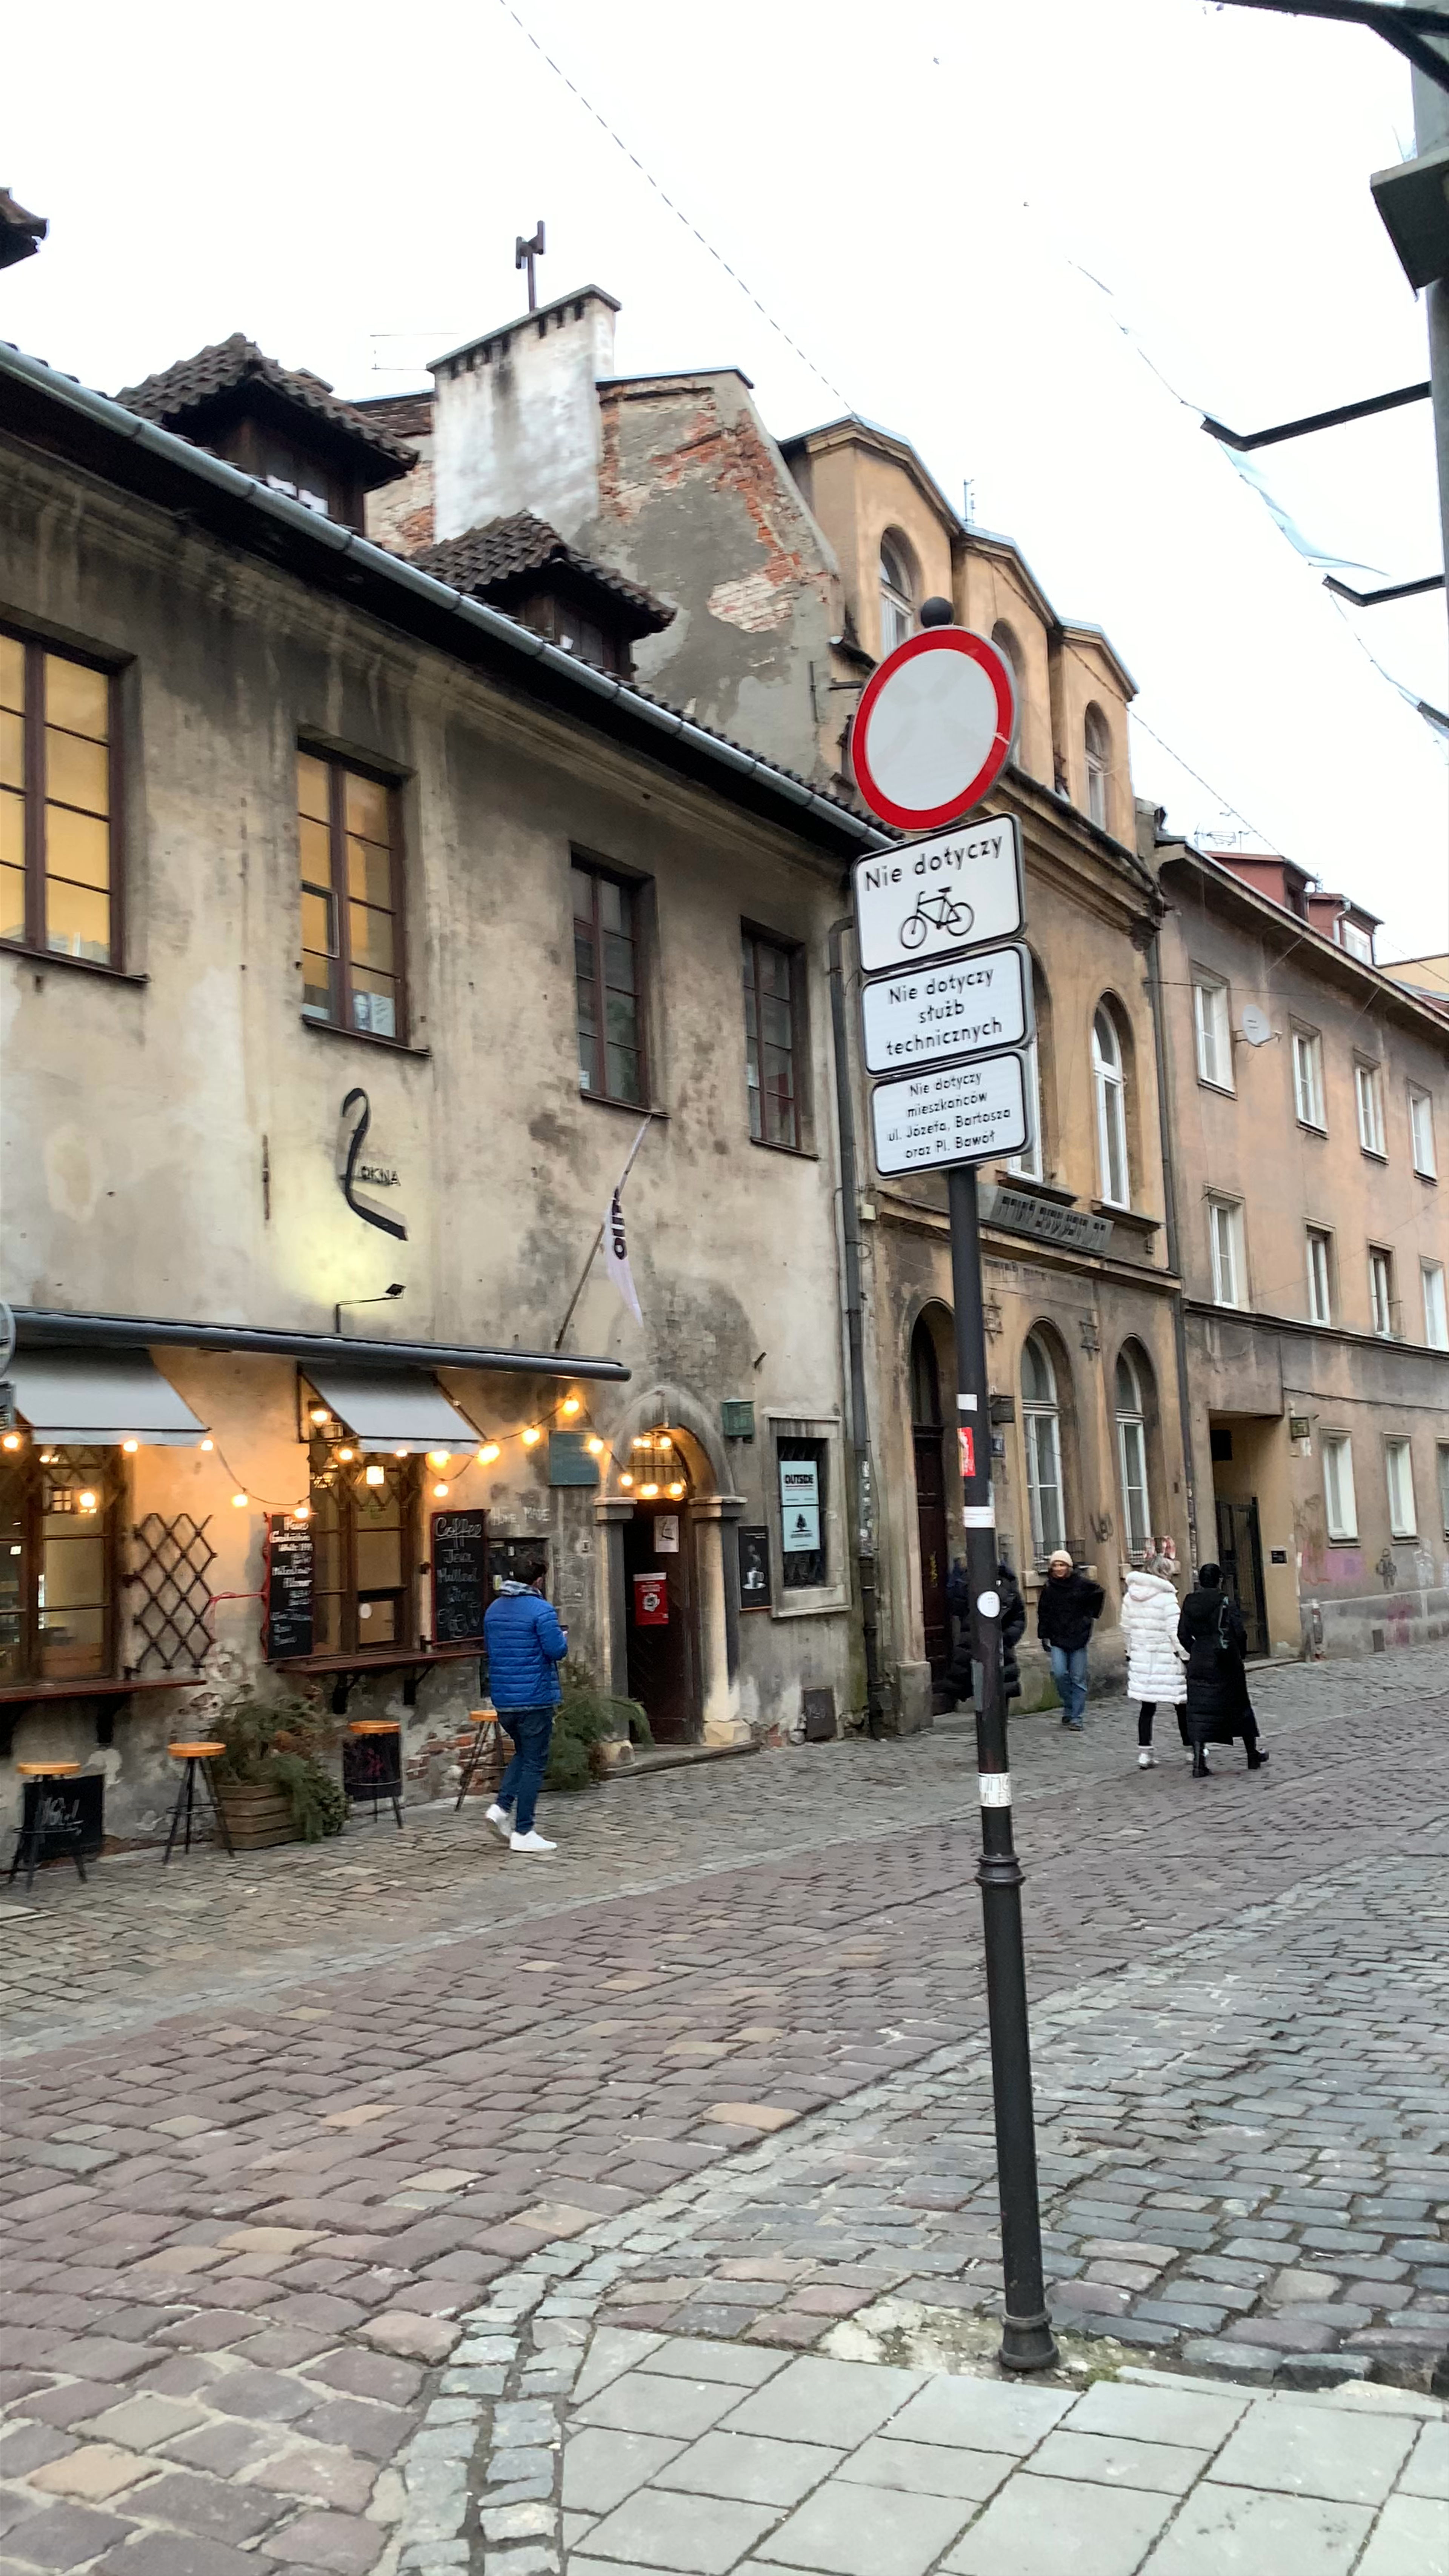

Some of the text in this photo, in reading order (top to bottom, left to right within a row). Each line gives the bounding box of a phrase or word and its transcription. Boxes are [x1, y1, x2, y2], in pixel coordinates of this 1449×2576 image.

[864, 836, 1002, 891] Nie dotyczy
[889, 969, 993, 1004] Nie dotyczy
[918, 999, 964, 1024] służb
[886, 1017, 1002, 1055] technicznych
[909, 1073, 981, 1096] Nie dotyczy
[907, 1090, 988, 1118] mieszkańców
[888, 1109, 1011, 1142] ul. Józefa, Bartosza
[906, 1130, 995, 1158] oraz Pl. Bawół
[361, 1166, 401, 1186] OKNA
[784, 1474, 814, 1484] OUTSIDE
